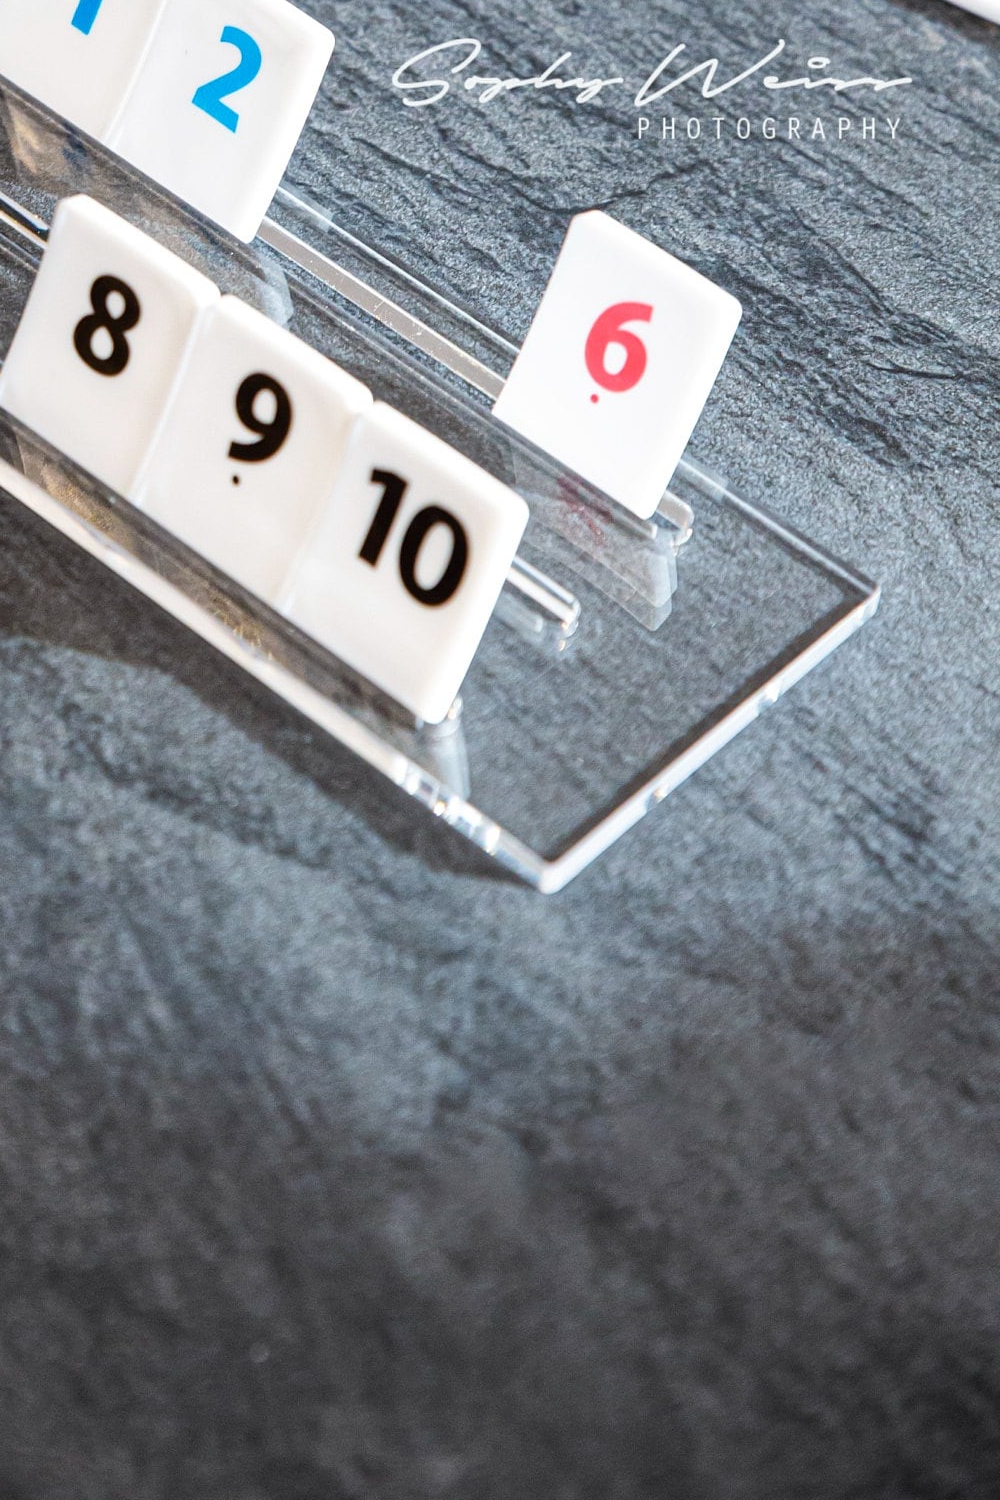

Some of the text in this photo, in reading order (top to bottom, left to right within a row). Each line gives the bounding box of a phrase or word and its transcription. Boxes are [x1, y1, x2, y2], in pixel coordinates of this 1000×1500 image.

[190, 24, 263, 134] 2
[584, 301, 654, 393] 6
[72, 274, 470, 608] 8 9 10
